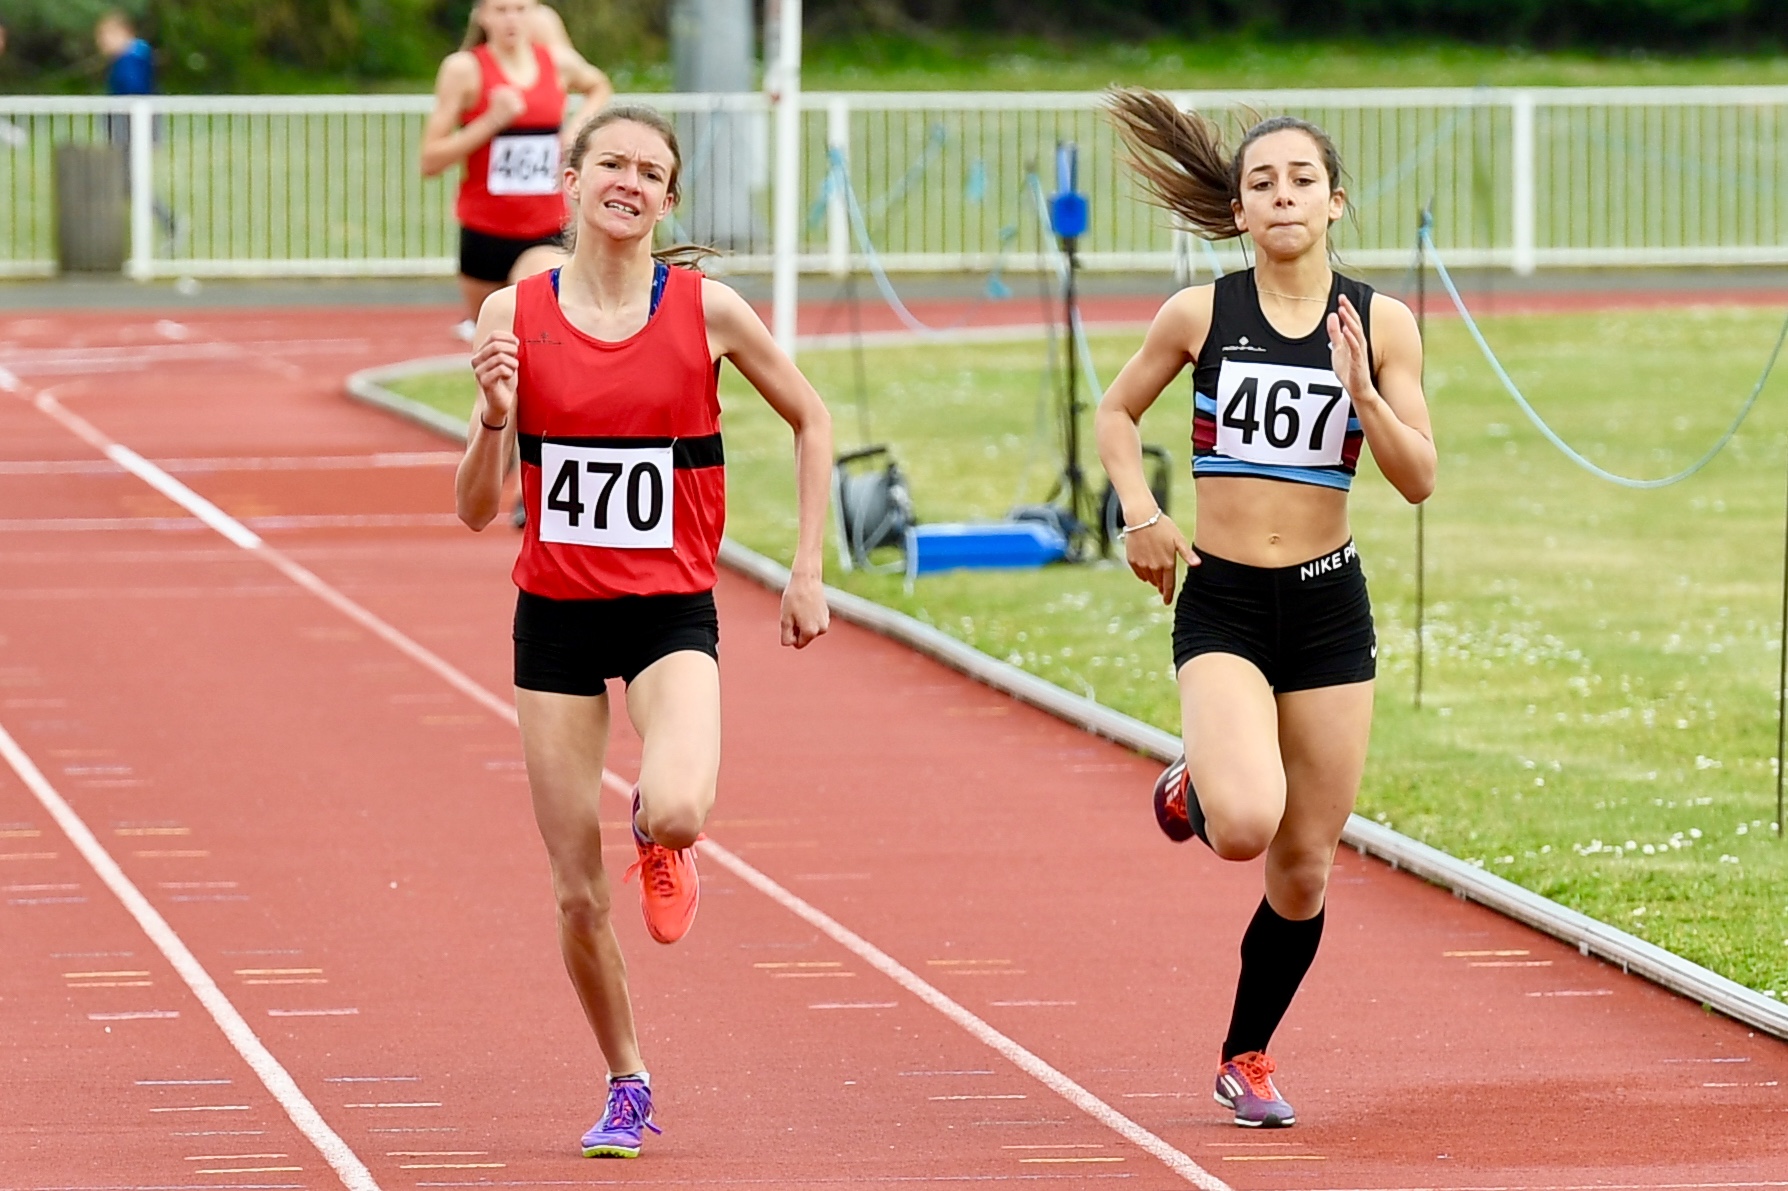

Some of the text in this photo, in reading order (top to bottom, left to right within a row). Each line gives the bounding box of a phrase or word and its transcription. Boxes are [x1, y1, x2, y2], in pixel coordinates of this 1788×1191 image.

[1222, 376, 1344, 451] 467
[547, 459, 664, 532] 470
[1300, 551, 1343, 582] NIKE
